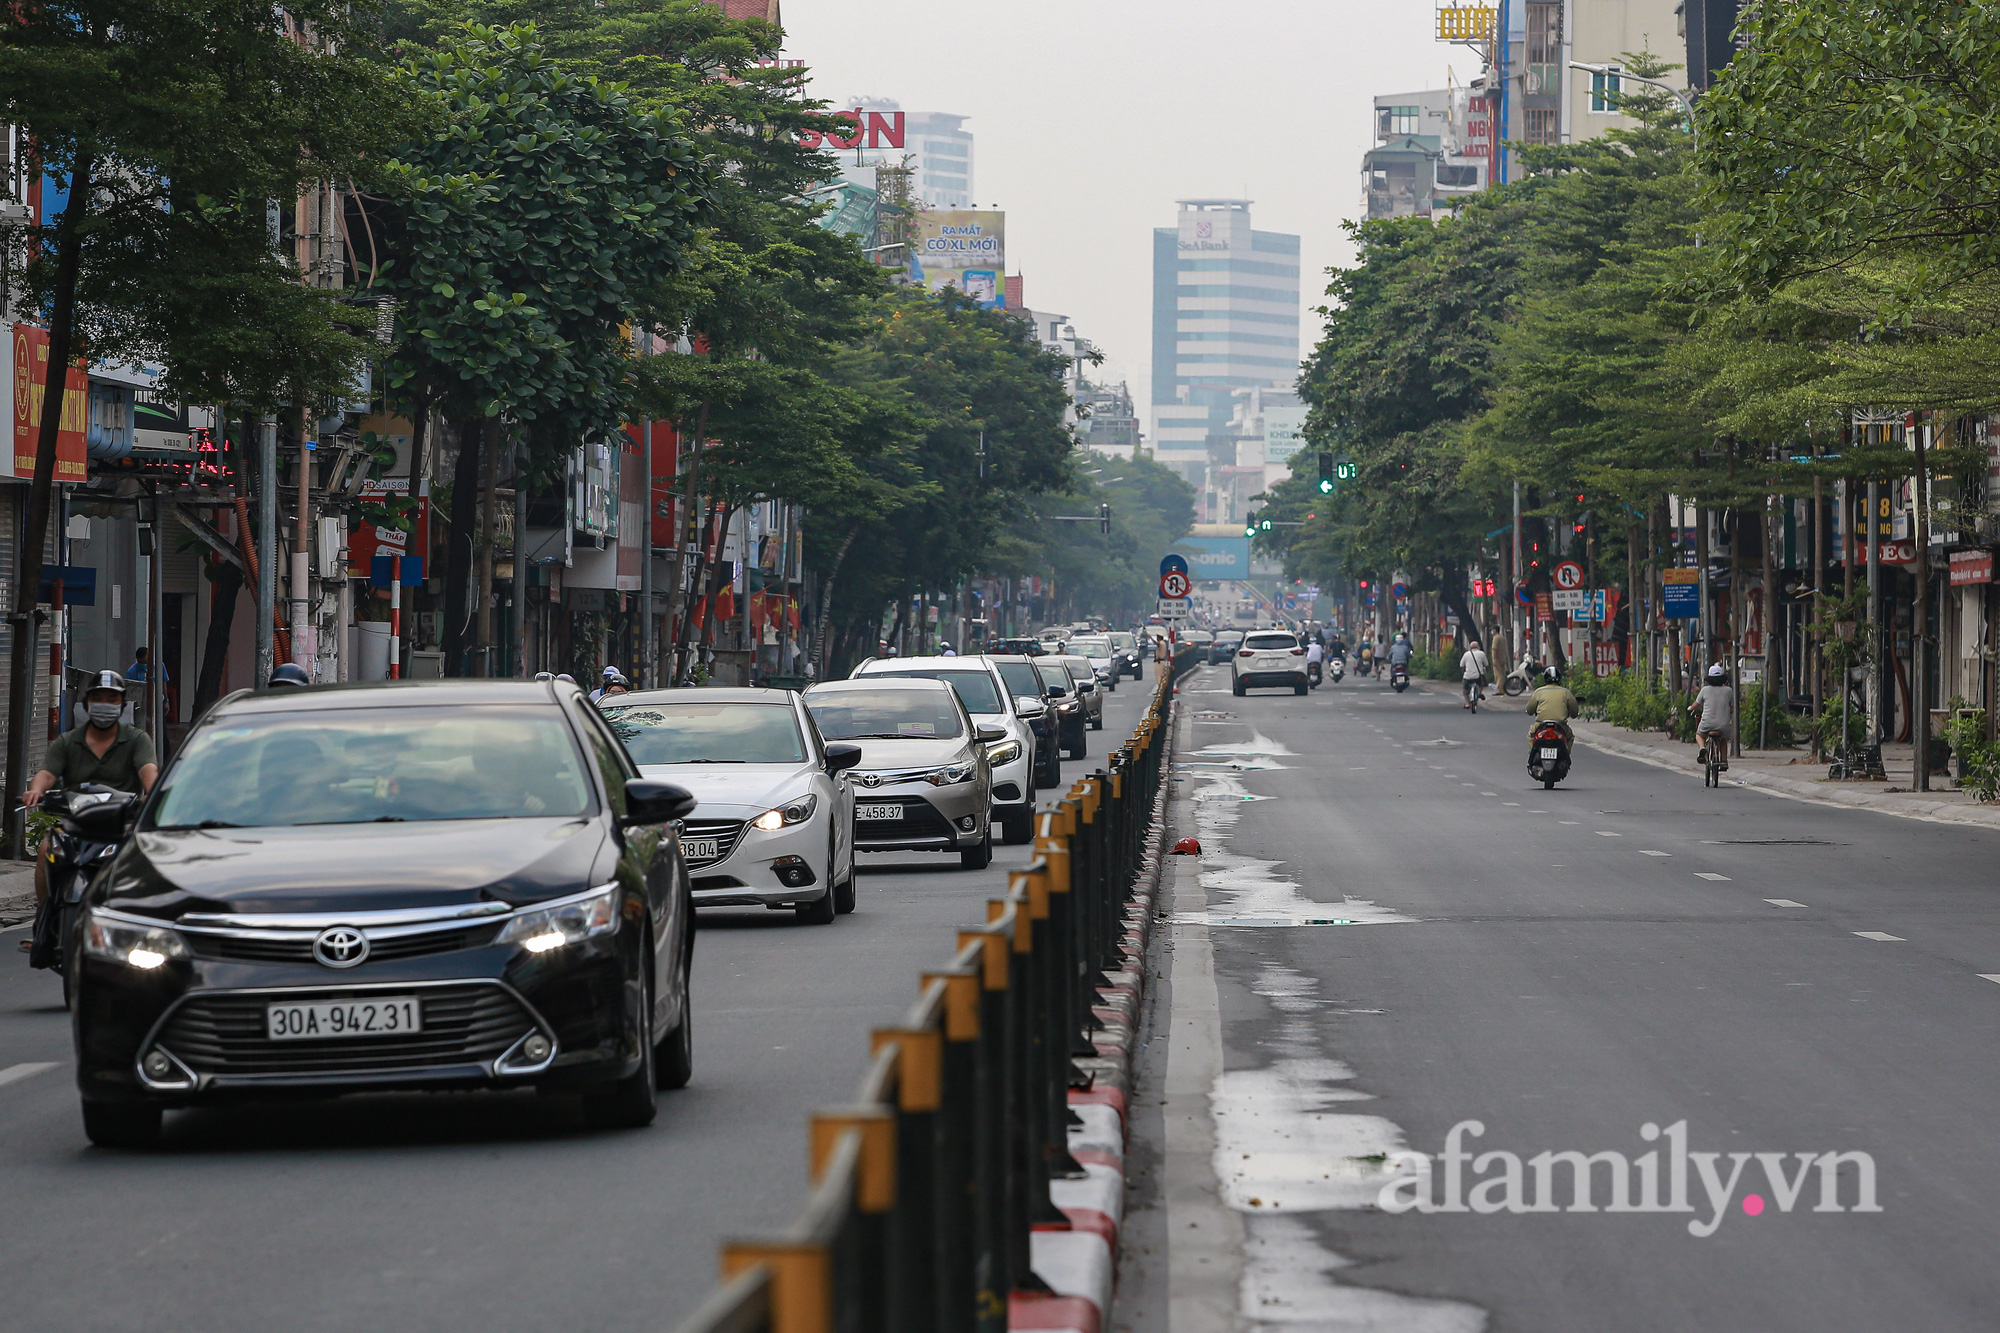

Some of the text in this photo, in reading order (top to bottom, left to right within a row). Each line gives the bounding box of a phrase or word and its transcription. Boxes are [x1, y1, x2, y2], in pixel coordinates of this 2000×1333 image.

[942, 224, 981, 235] RA MẮT
[927, 237, 997, 250] CỠ XL MỚI
[1178, 240, 1230, 251] SeABank
[1861, 497, 1890, 518] 18
[385, 531, 404, 541] THẤP
[855, 806, 902, 819] E-458.37
[680, 842, 715, 857] 38.04
[273, 1003, 412, 1035] 30A-942.31
